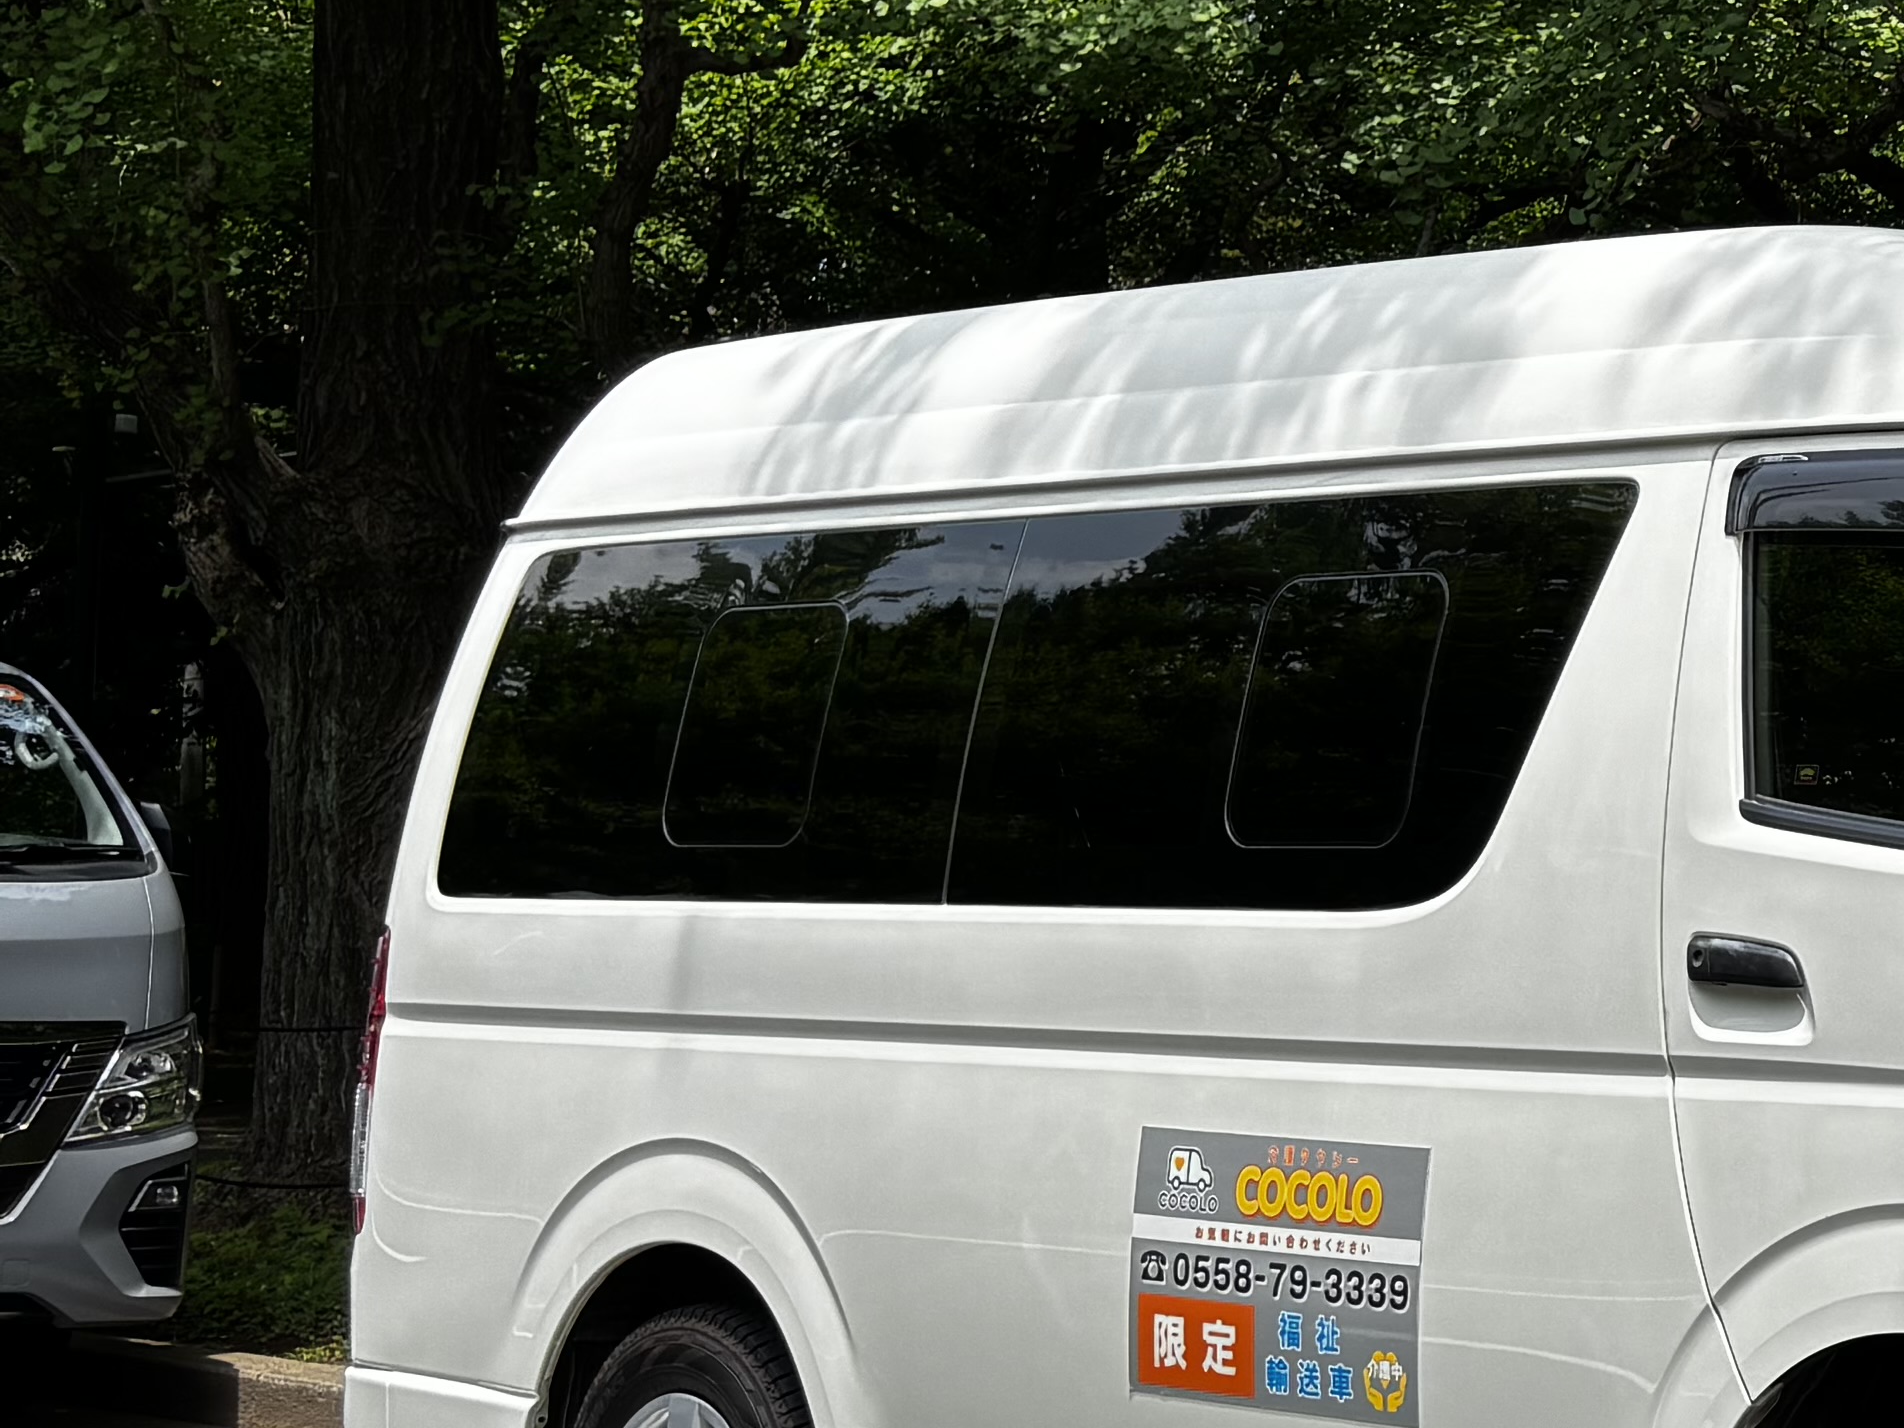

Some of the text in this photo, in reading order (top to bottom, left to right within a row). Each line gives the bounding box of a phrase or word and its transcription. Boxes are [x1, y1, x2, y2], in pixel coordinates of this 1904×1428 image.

[1158, 1190, 1219, 1214] COCOLO
[1235, 1164, 1384, 1228] COCOLO
[1173, 1253, 1410, 1313] 0558-79-3339
[1153, 1313, 1237, 1377] 限定
[1277, 1310, 1341, 1355] 福祉
[1264, 1357, 1355, 1402] 輸送車
